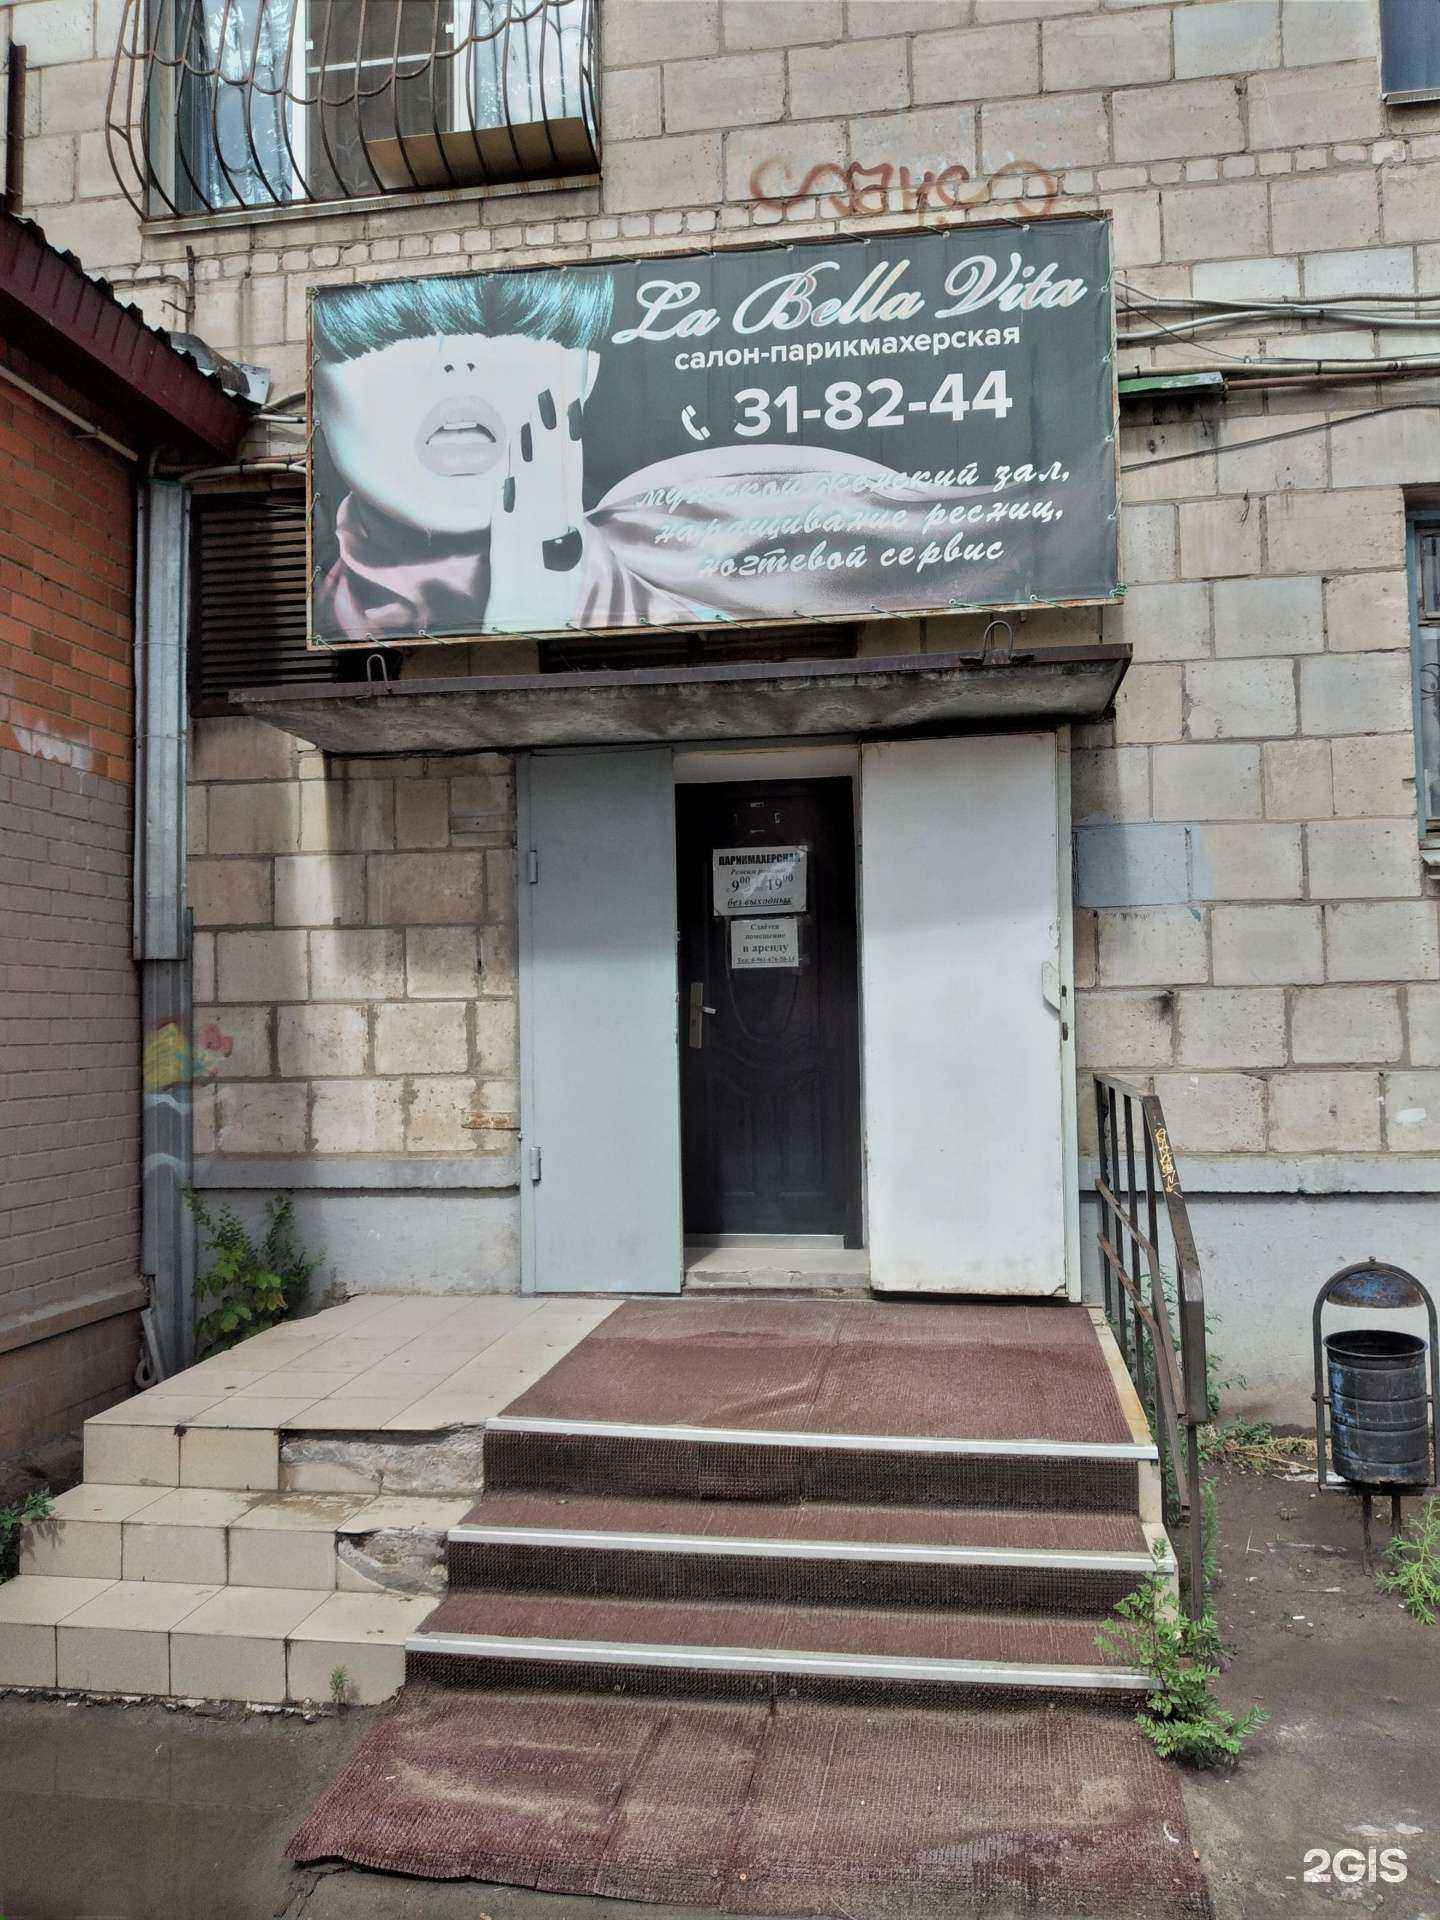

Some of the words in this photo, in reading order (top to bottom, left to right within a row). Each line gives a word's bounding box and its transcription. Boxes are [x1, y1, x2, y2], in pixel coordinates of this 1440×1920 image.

[611, 279, 721, 345] La
[732, 259, 926, 335] Bella
[934, 251, 1089, 319] Vita
[674, 326, 1021, 371] салон-парикмахерская
[733, 369, 1013, 437] 31-82-44
[994, 461, 1070, 493] зал,
[922, 499, 1064, 535] ресниц,
[700, 541, 869, 579] ногтевой
[880, 531, 1005, 574] сервис
